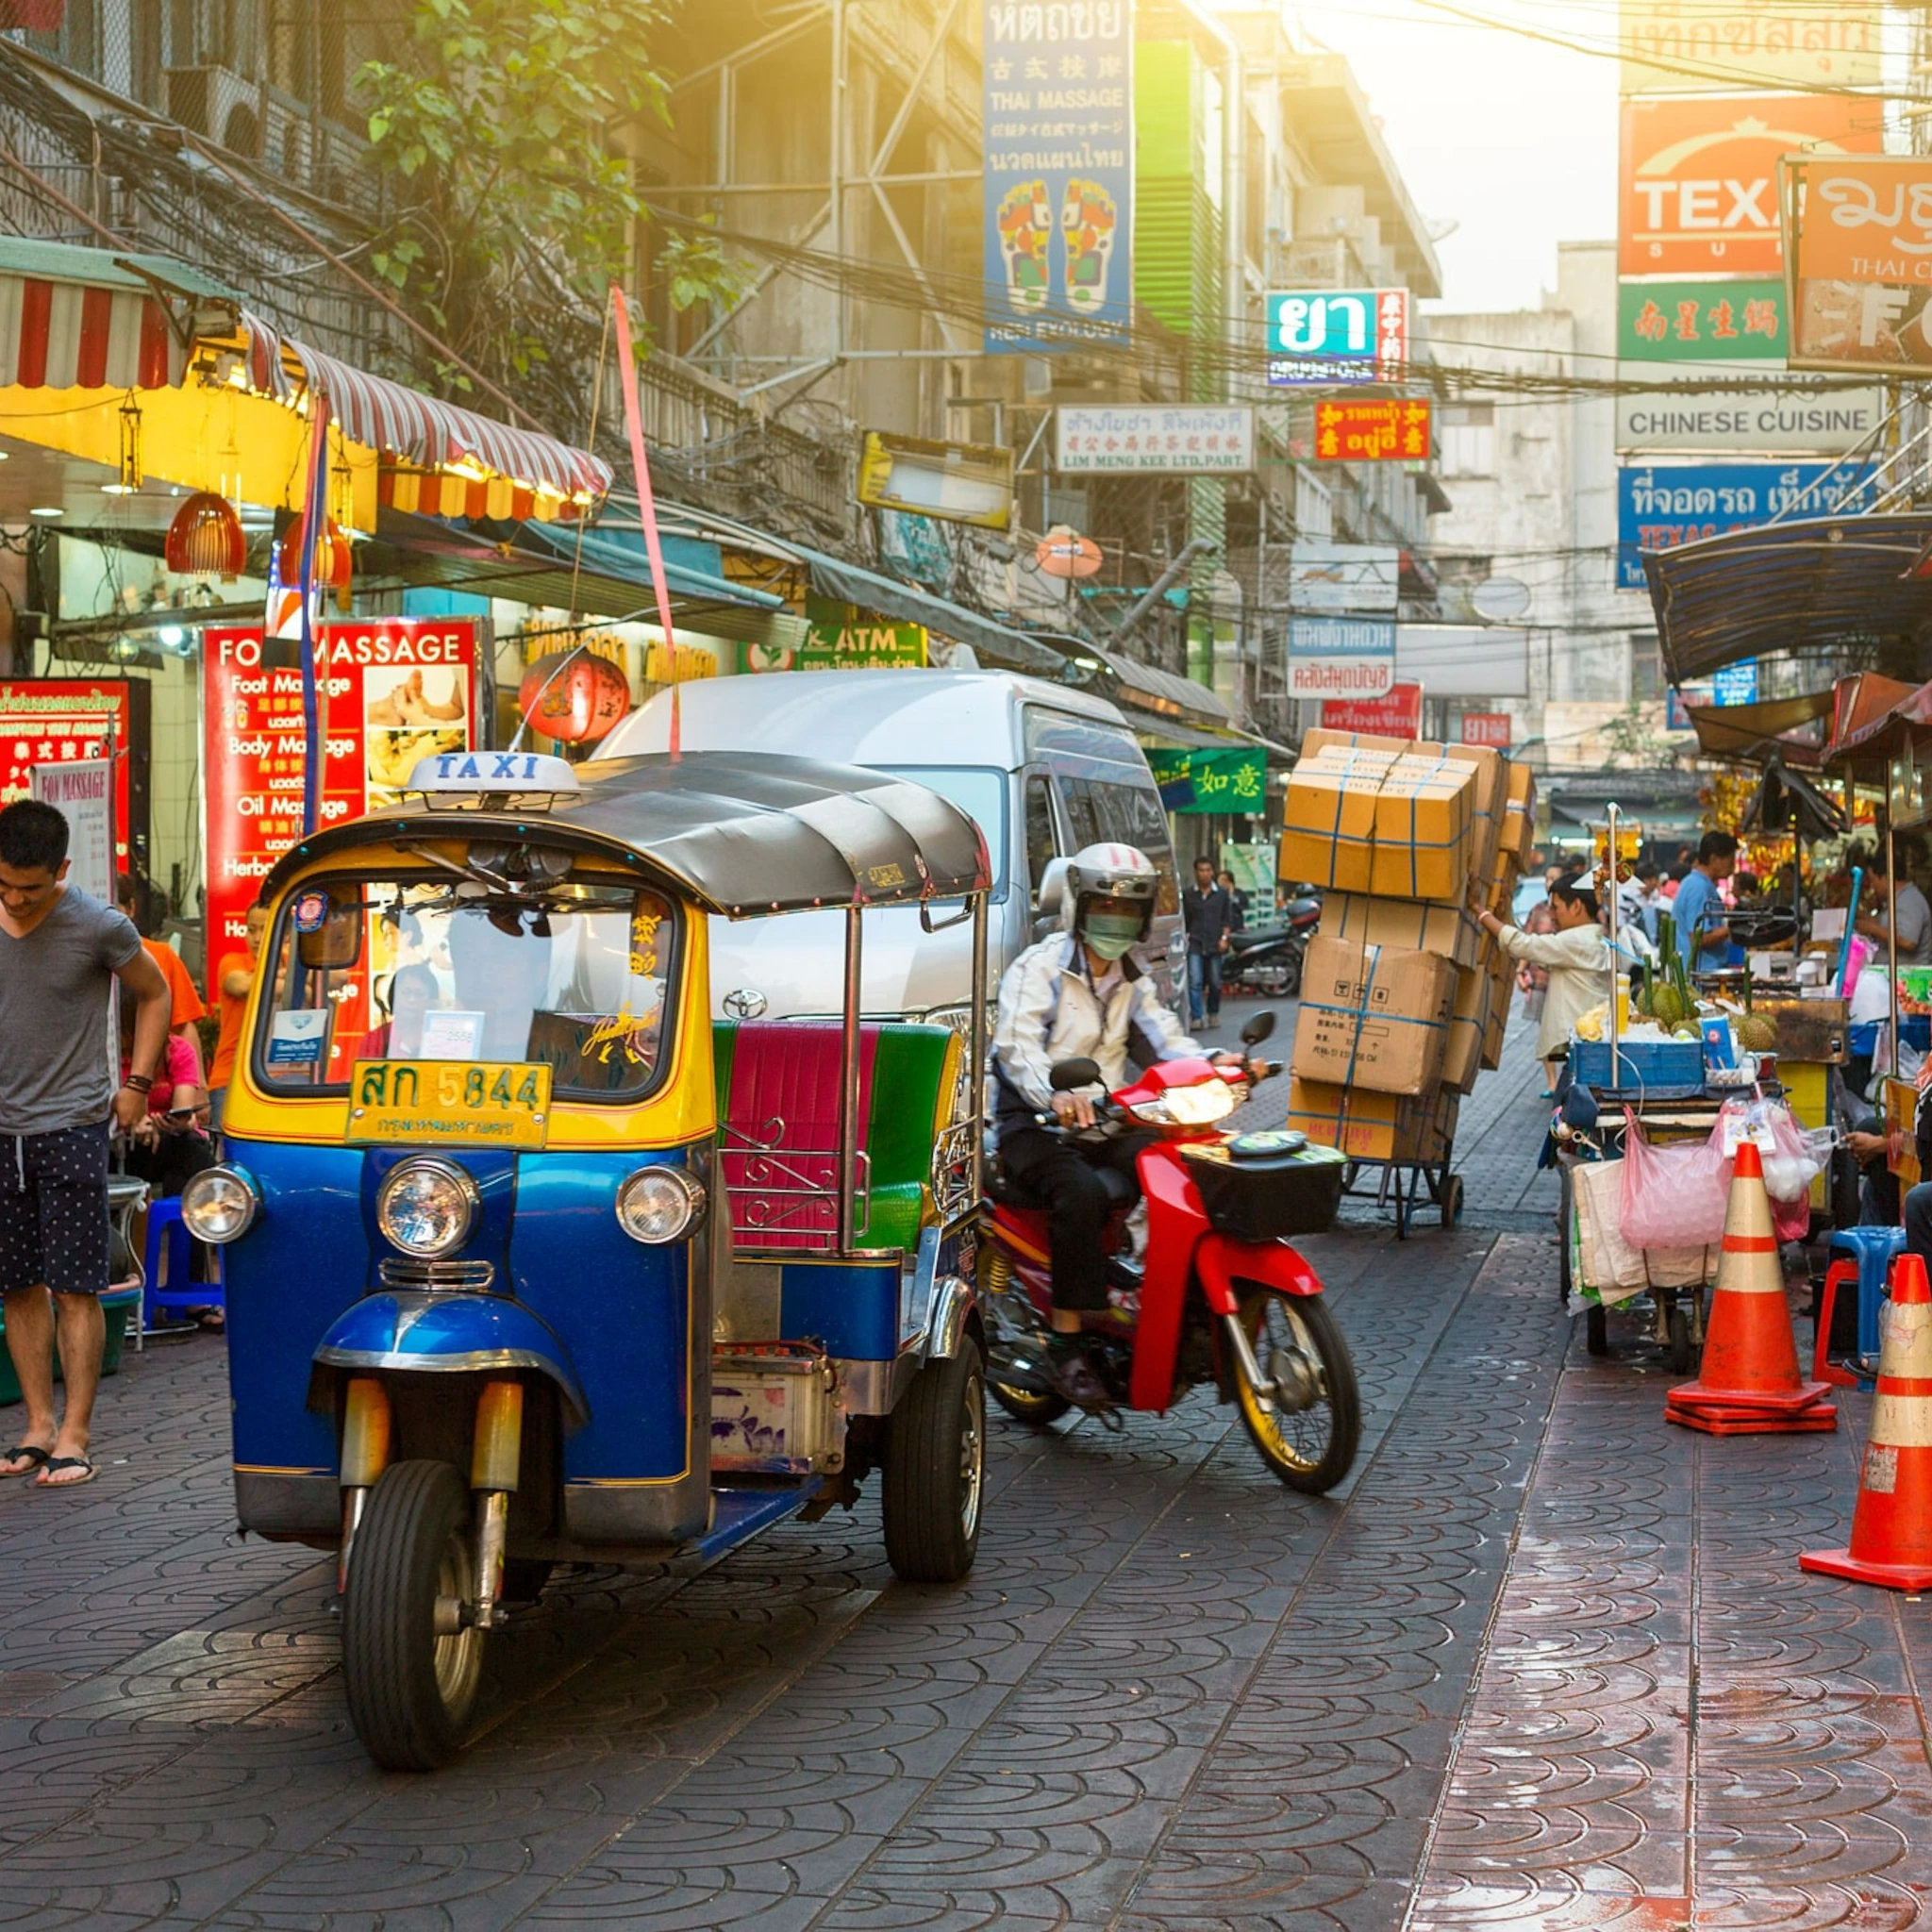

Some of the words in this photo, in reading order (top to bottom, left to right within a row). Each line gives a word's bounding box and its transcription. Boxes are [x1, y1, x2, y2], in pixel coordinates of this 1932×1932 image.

[1038, 88, 1124, 109] MASSAGE
[990, 142, 1124, 172] นวดแผนไทย
[1634, 177, 1783, 229] TEX
[1851, 257, 1906, 277] THAI
[1278, 297, 1366, 352] ยา
[1629, 412, 1749, 434] CHINESE
[1757, 409, 1869, 433] CUISINE
[1064, 456, 1090, 468] LIM
[1094, 456, 1134, 468] MENG
[1140, 456, 1168, 468] KEE
[1631, 469, 1757, 516] ที่จอดรถ
[219, 638, 262, 667] FO
[834, 628, 896, 652] ATM
[231, 675, 268, 694] Foot
[229, 734, 272, 758] Body
[436, 756, 539, 778] TAXI
[62, 771, 106, 801] MASSAGE
[1195, 764, 1261, 797] 如意
[237, 796, 264, 816] Oil
[361, 1063, 418, 1107] สก
[437, 1066, 538, 1110] 5844
